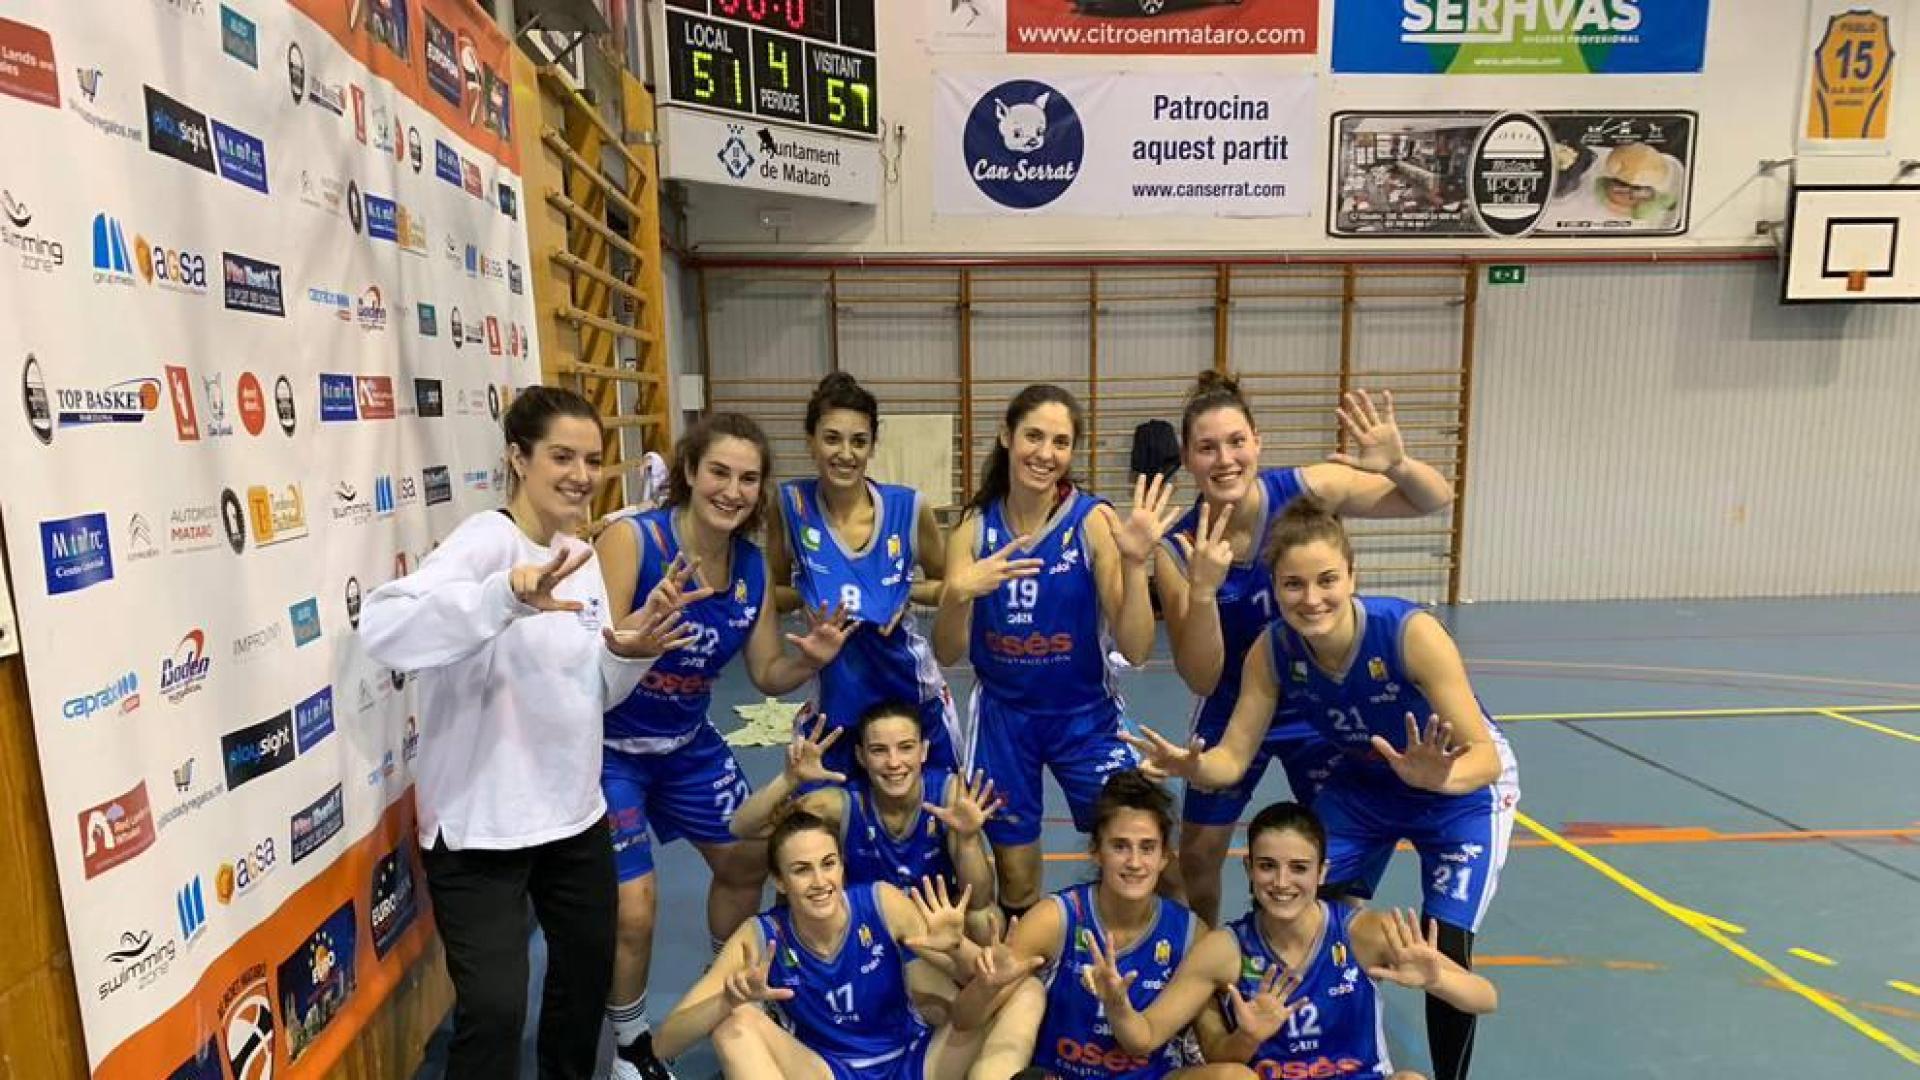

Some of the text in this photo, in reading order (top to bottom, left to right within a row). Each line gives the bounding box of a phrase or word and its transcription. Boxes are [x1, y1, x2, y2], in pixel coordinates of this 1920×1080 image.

[684, 21, 733, 53] LOCAL
[1018, 24, 1305, 45] www.citroenmataro.com
[767, 41, 789, 89] 4
[812, 49, 862, 79] VISITANT
[1835, 40, 1876, 80] 15
[693, 51, 742, 105] 51
[827, 78, 870, 127] 57
[1154, 94, 1269, 121] Patrocina
[1132, 135, 1288, 166] aquest partit
[759, 161, 831, 187] de Mataró
[973, 158, 1077, 183] Can Serrat
[1132, 182, 1286, 198] www.canserrat.com
[57, 388, 85, 409] TOP
[86, 388, 147, 411] BASKET
[842, 584, 862, 612] 8
[1006, 579, 1039, 608] 19
[1251, 589, 1272, 615] 7
[1327, 706, 1368, 731] 21
[1431, 866, 1472, 901] 21
[825, 982, 855, 1013] 17
[1286, 1002, 1322, 1038] 12
